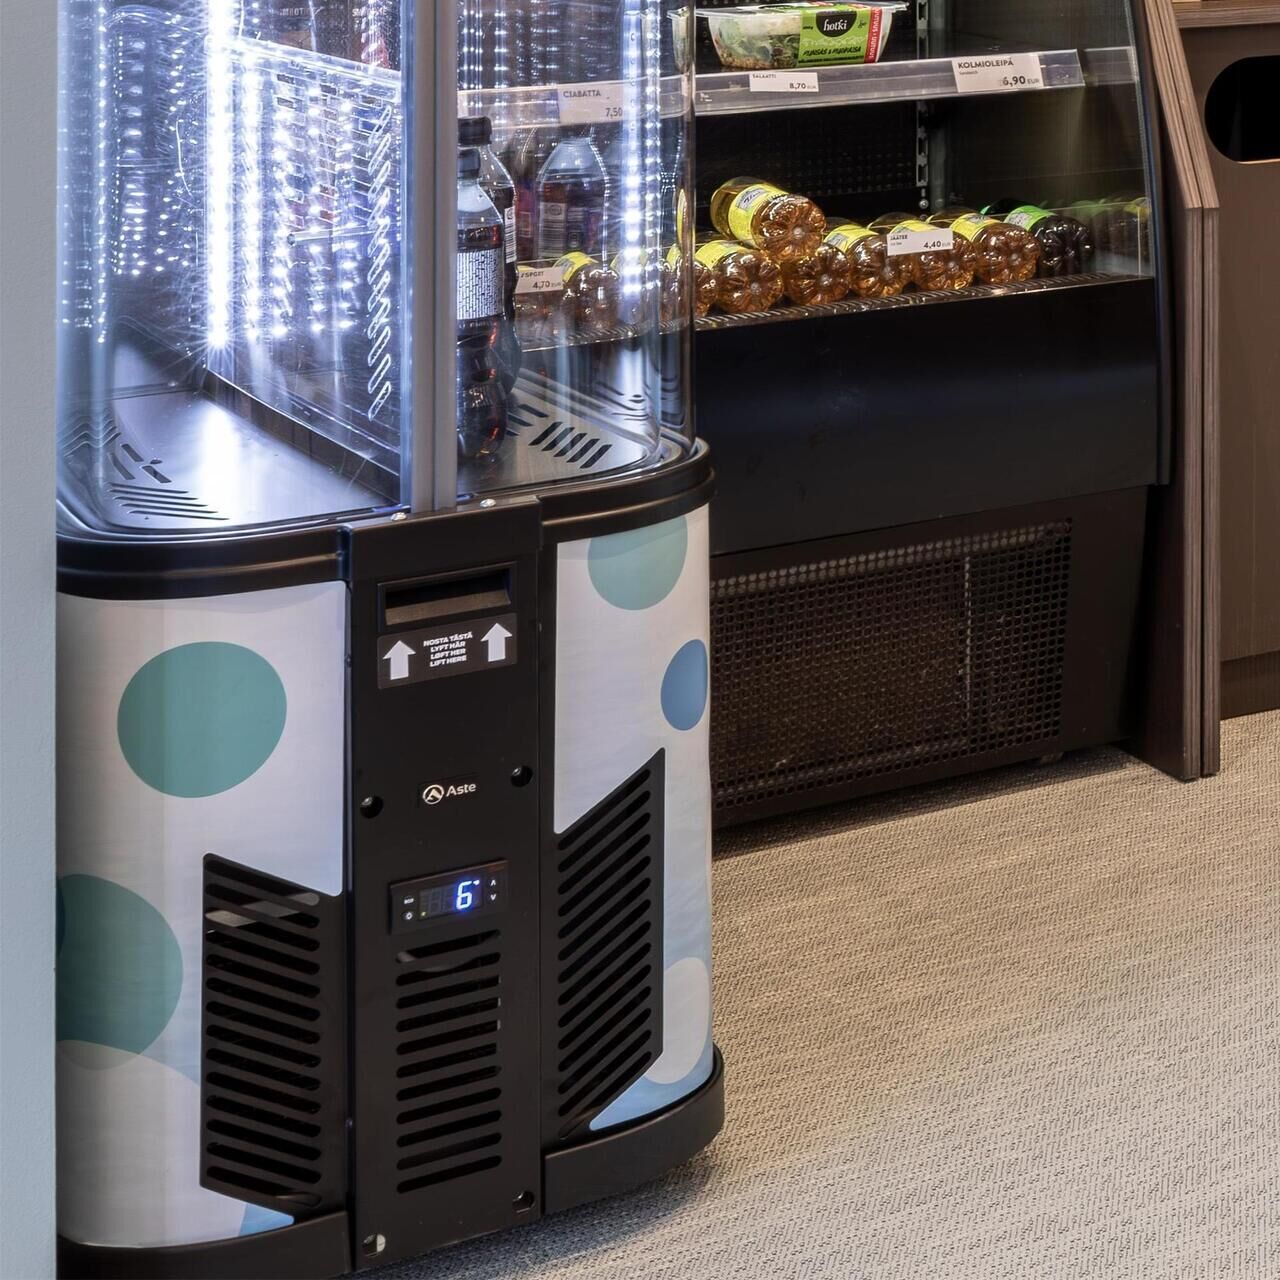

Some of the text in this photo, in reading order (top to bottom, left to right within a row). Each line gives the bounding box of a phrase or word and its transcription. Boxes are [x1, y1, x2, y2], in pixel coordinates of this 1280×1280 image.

[957, 57, 1014, 69] KOLMIOLEIPÄ
[789, 82, 806, 90] 8,70
[1002, 75, 1026, 87] 6,90
[563, 89, 601, 98] CIABATTA
[605, 107, 623, 119] 7,50
[923, 240, 942, 249] 4,40
[532, 281, 550, 289] 4,70
[423, 631, 473, 647] NOSTA TÄSTÄ
[430, 640, 466, 653] LYFT HÄR
[450, 648, 466, 656] HER
[430, 654, 467, 667] LIFT HERE
[446, 782, 477, 798] Aste
